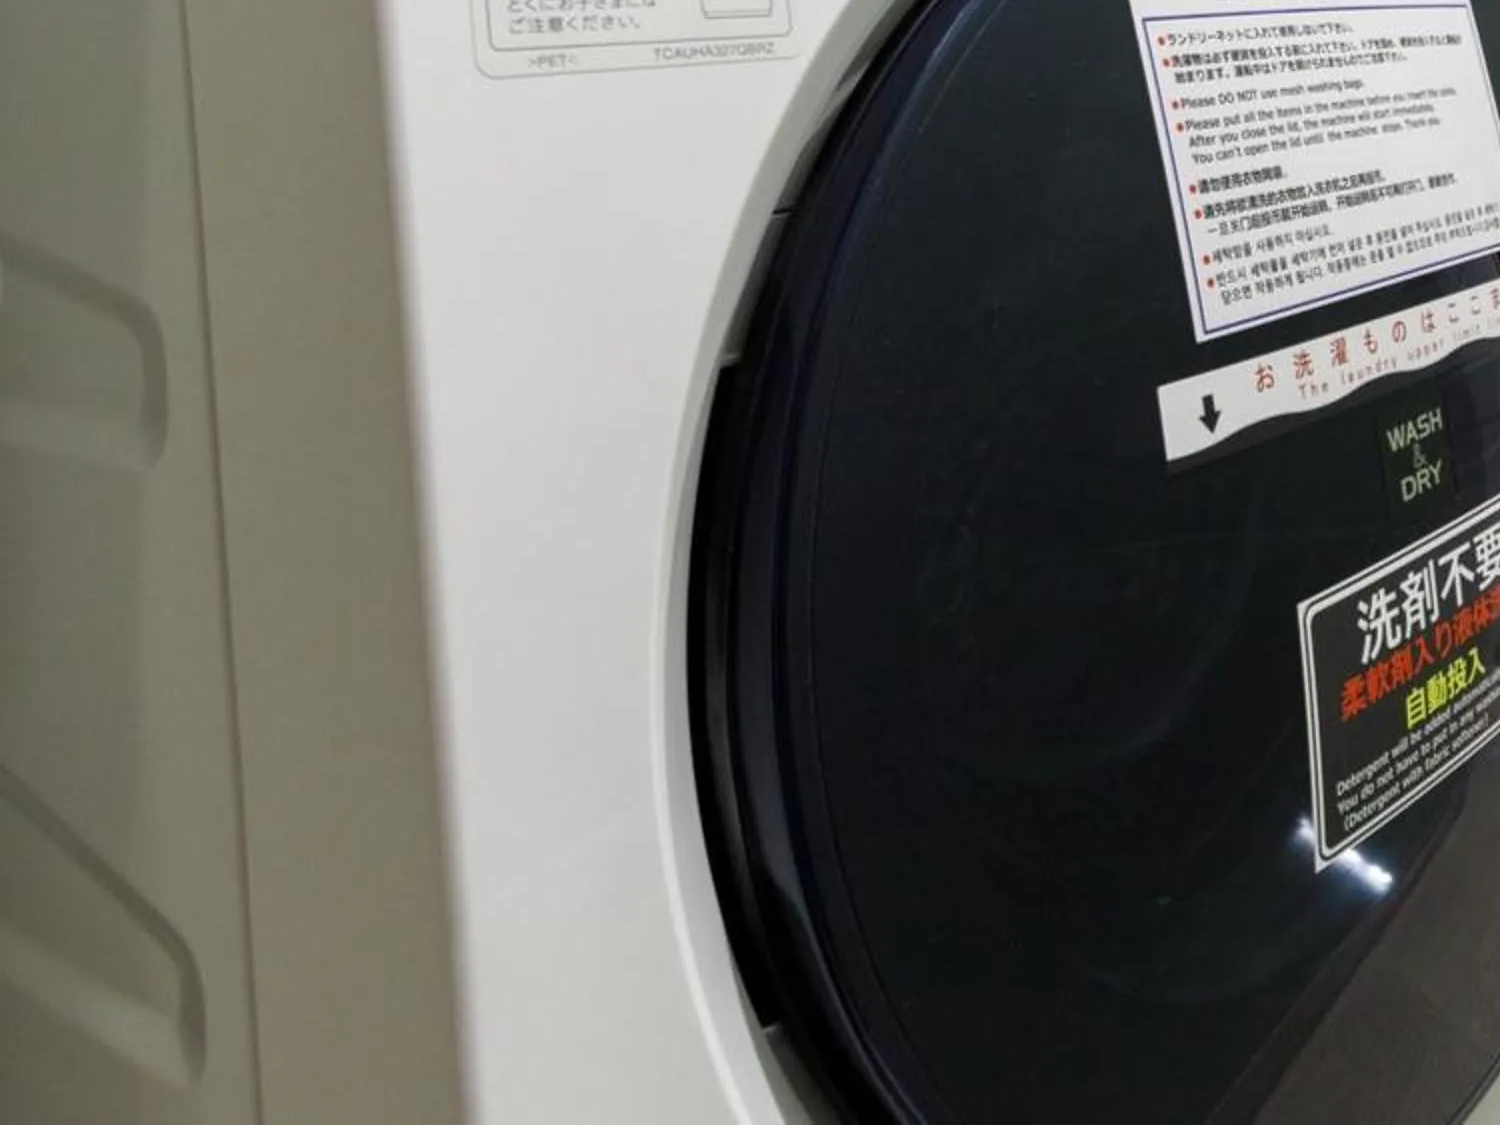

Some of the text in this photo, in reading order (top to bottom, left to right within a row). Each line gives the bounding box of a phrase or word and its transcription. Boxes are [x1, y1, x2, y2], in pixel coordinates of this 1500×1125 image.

[1386, 408, 1443, 453] WASH
[1400, 460, 1443, 503] DRY
[1405, 645, 1486, 731] 自動投入
